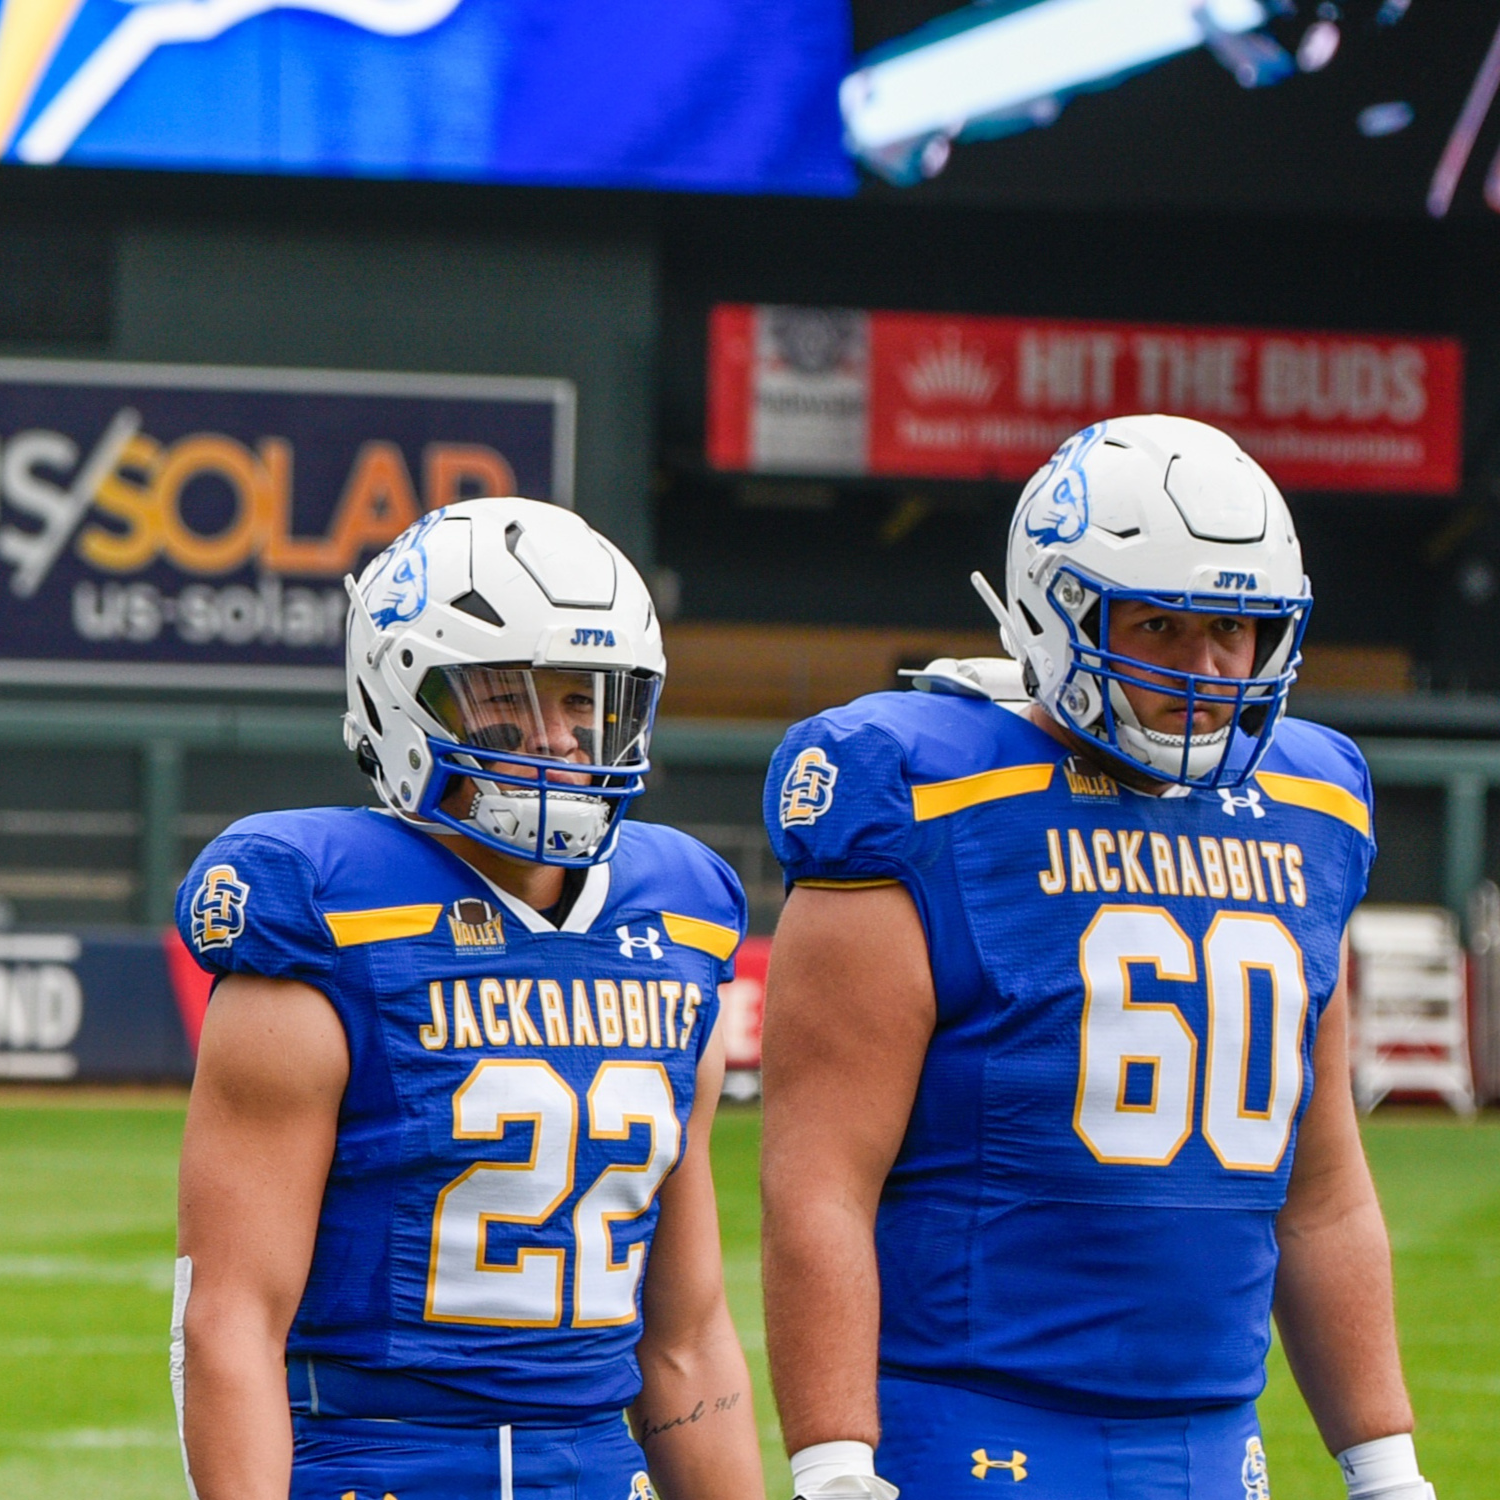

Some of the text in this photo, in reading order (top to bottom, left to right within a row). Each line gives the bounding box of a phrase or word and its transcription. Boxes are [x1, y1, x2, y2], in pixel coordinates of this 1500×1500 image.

[1018, 329, 1427, 422] HIT THE BUDS
[570, 627, 616, 647] JFPA
[1039, 829, 1307, 907] JACKRABBITS
[446, 913, 506, 947] VALLEY
[419, 978, 701, 1050] JACKRABBITS
[1072, 904, 1308, 1172] 60
[424, 1058, 681, 1328] 22
